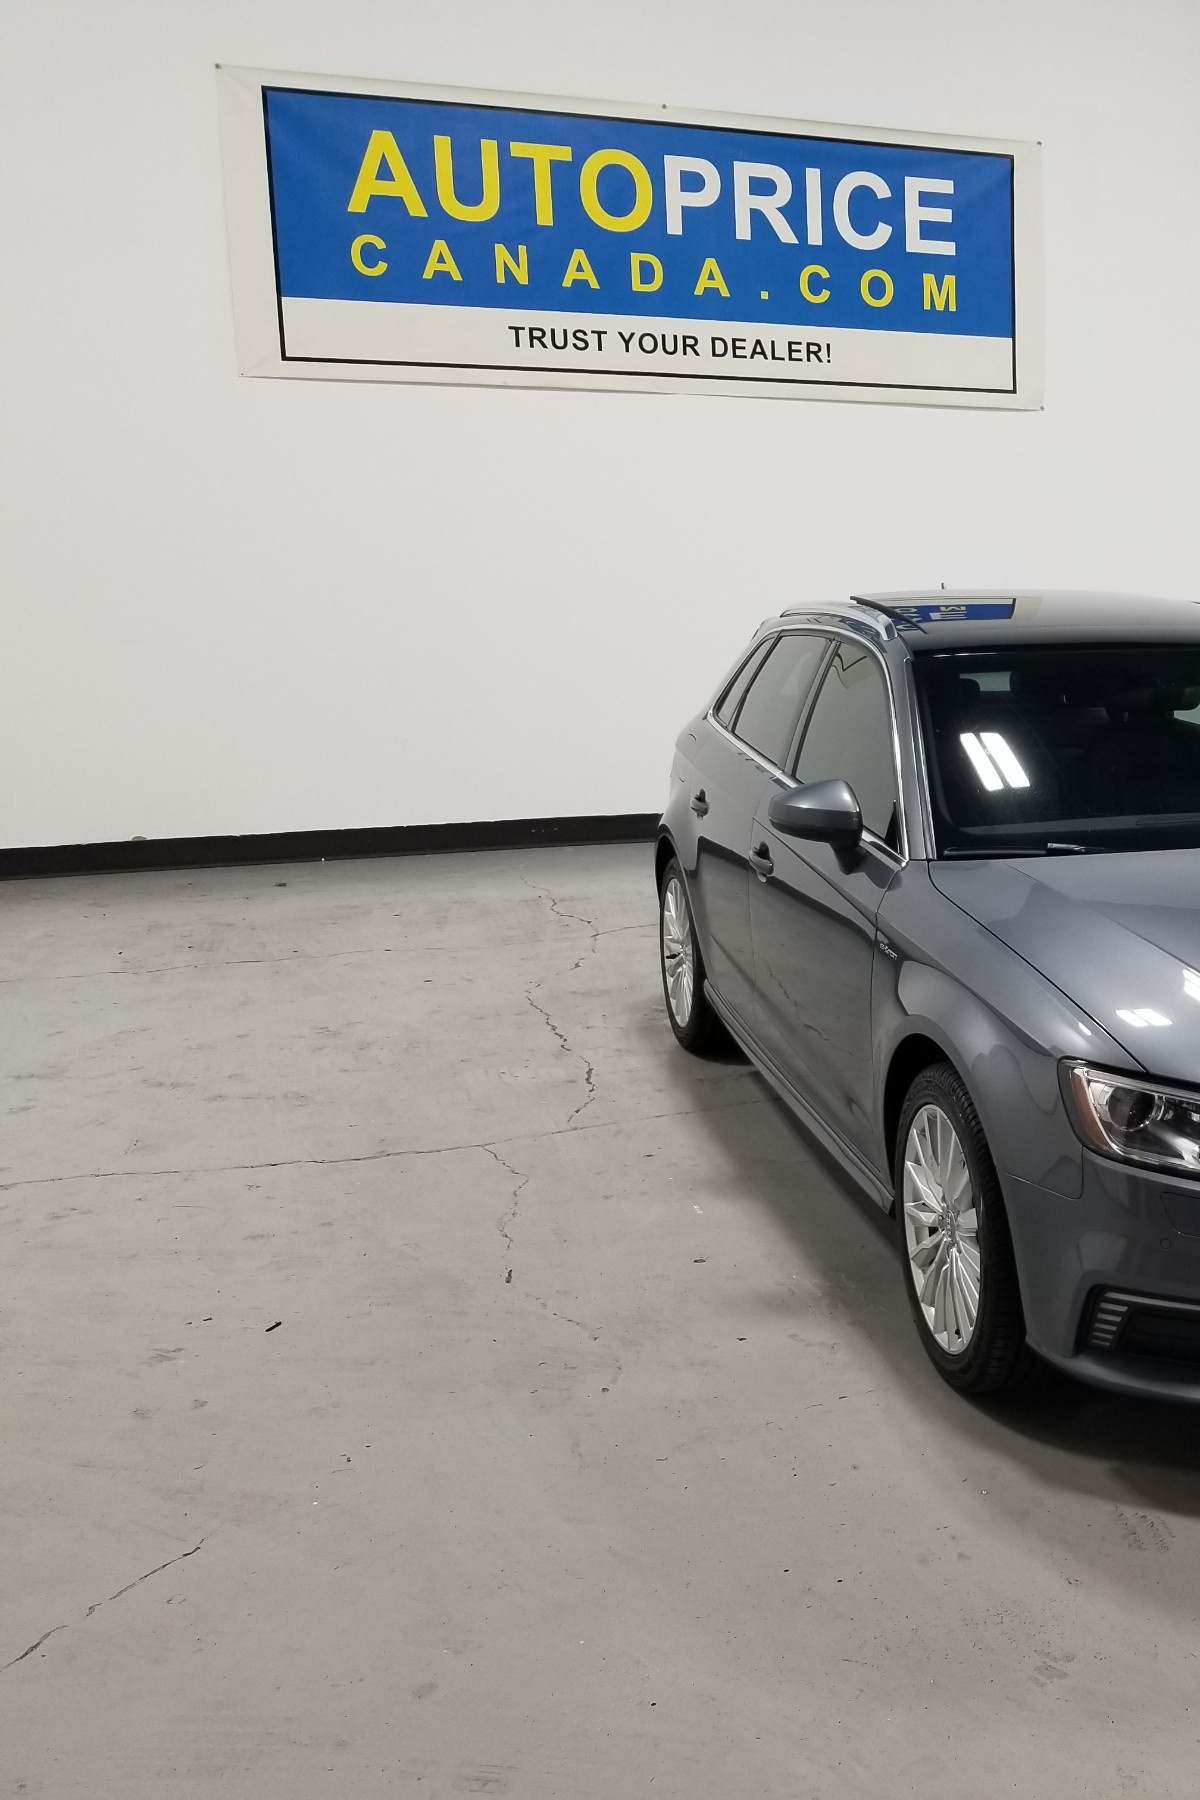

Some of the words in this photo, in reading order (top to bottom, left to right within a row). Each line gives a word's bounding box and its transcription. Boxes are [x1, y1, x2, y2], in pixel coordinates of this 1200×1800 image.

[347, 129, 957, 256] AUTOPRICE
[350, 234, 958, 313] CANADA.COM
[507, 325, 608, 352] TRUST
[617, 331, 701, 357] YOUR
[710, 336, 833, 364] DEALER!
